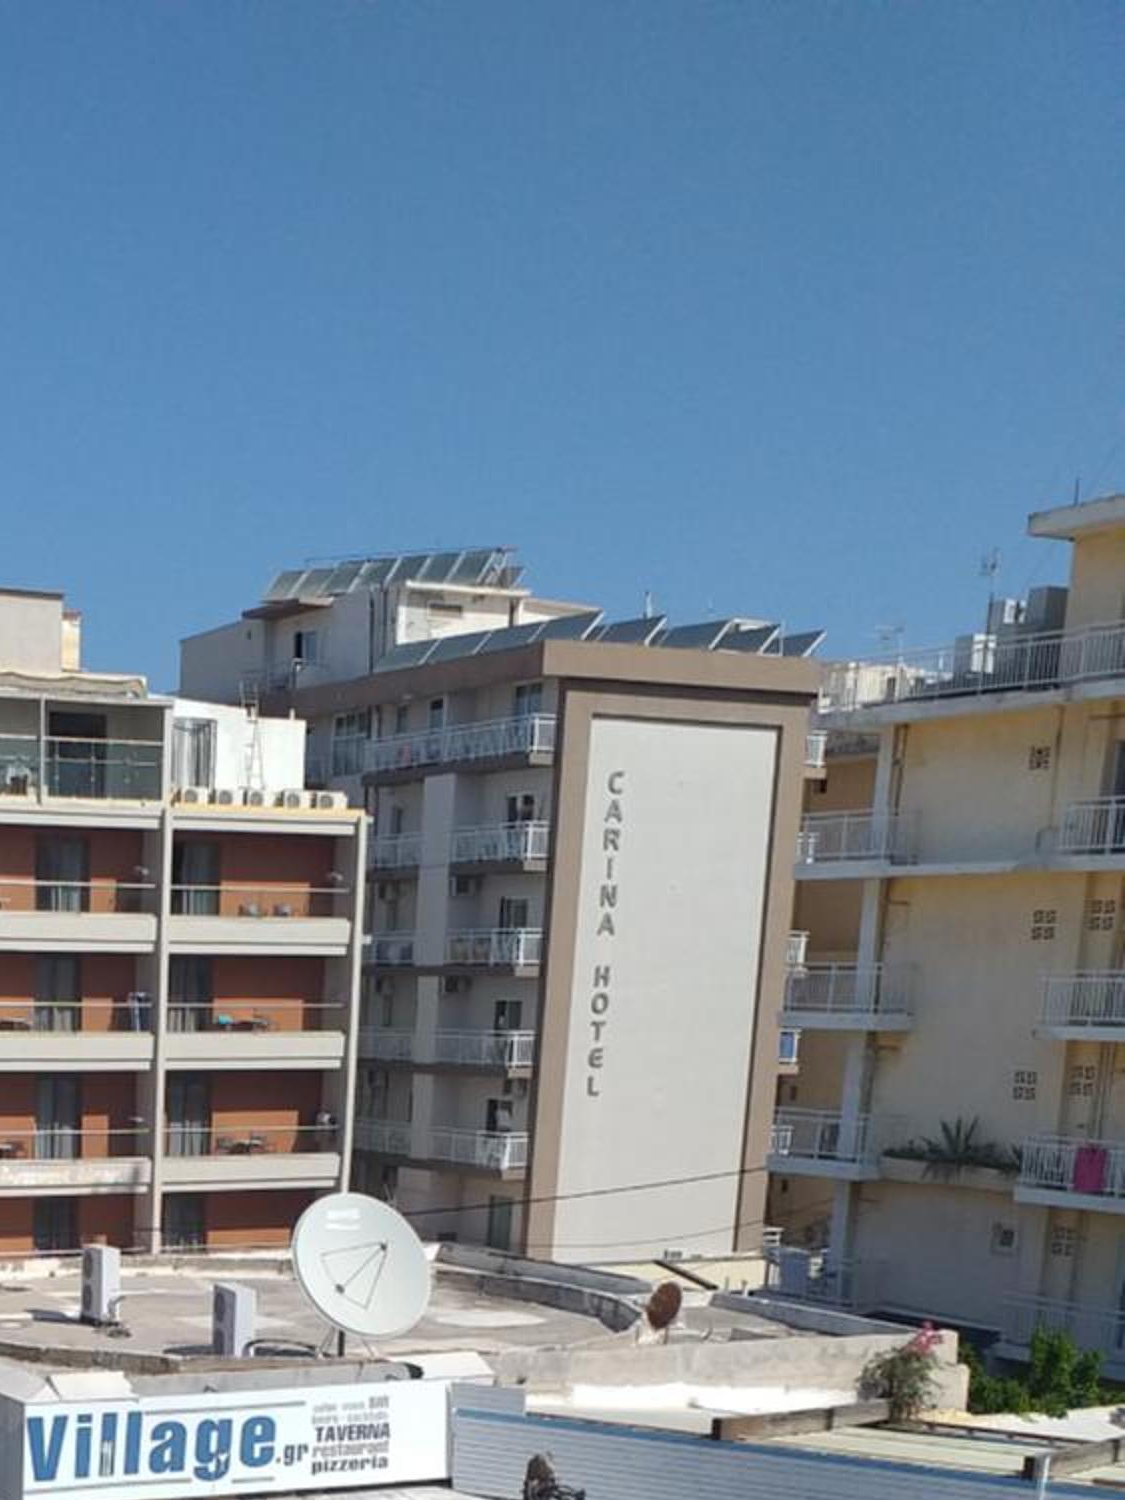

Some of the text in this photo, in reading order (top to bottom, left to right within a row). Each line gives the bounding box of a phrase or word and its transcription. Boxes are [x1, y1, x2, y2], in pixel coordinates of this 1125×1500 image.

[586, 770, 626, 1097] CARINA HOTEL
[315, 1422, 391, 1443] TAVERNA
[312, 1441, 389, 1458] restaurant
[311, 1456, 388, 1476] pizzeria
